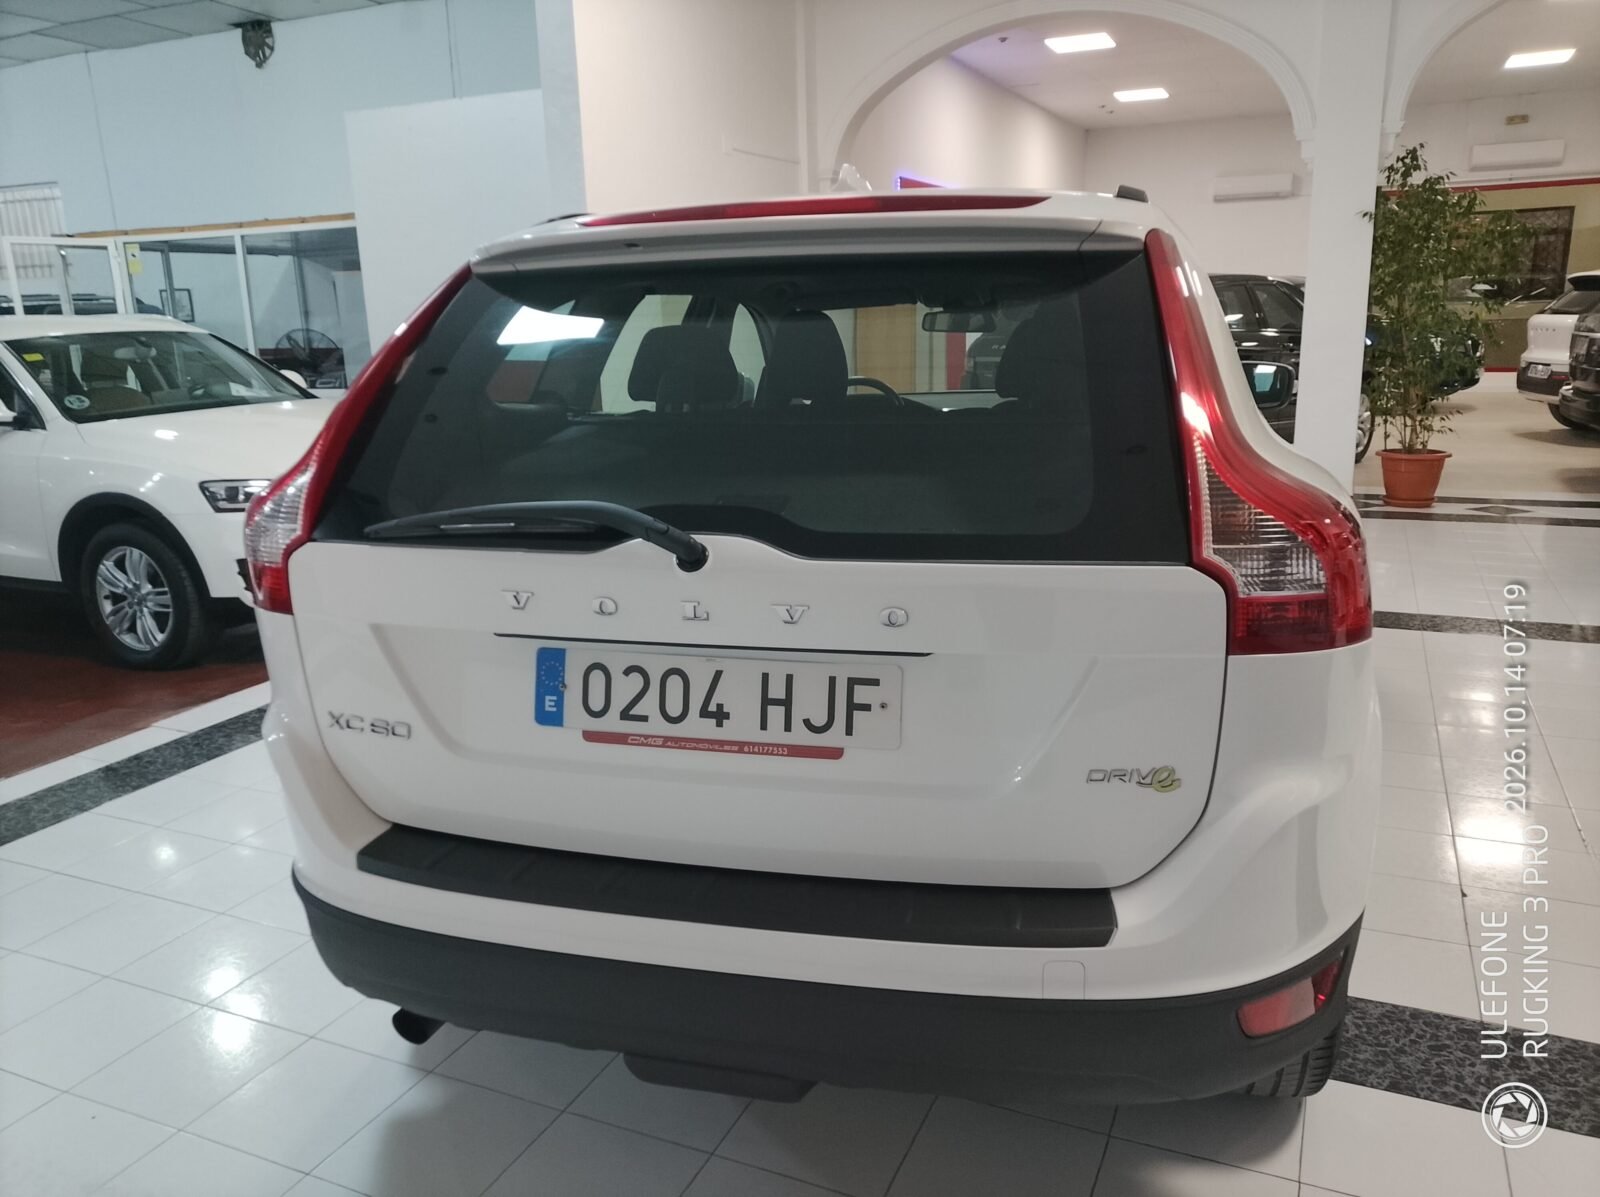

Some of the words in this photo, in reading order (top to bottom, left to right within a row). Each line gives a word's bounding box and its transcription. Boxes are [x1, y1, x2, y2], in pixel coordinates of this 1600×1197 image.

[501, 589, 909, 628] VOLVO
[544, 695, 557, 712] E
[582, 662, 730, 728] 0204
[759, 672, 880, 737] HJF
[627, 736, 664, 745] CMG
